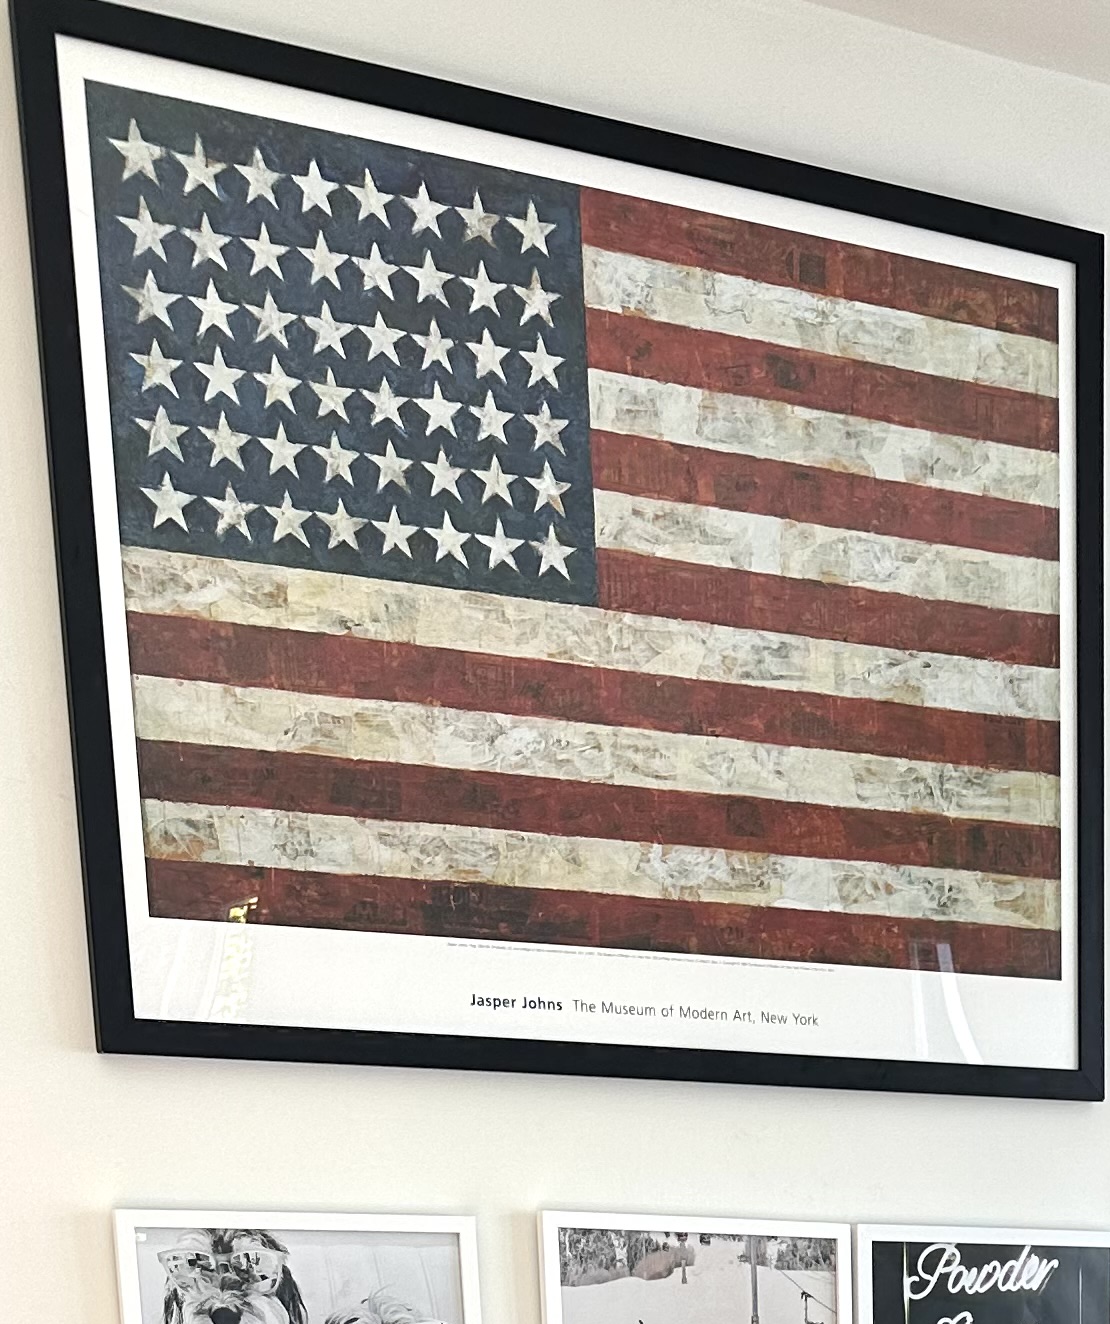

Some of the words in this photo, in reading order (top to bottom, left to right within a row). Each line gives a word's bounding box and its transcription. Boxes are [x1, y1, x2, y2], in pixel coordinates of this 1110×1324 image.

[470, 993, 517, 1011] Jasper
[522, 996, 563, 1011] Johns
[573, 999, 596, 1013] The
[601, 1000, 656, 1016] Museum
[661, 1004, 674, 1018] of
[679, 1005, 728, 1021] Modern
[733, 1009, 755, 1024] Art,
[761, 1010, 788, 1025] New
[792, 1012, 819, 1027] York
[907, 1243, 1059, 1300] Powder
